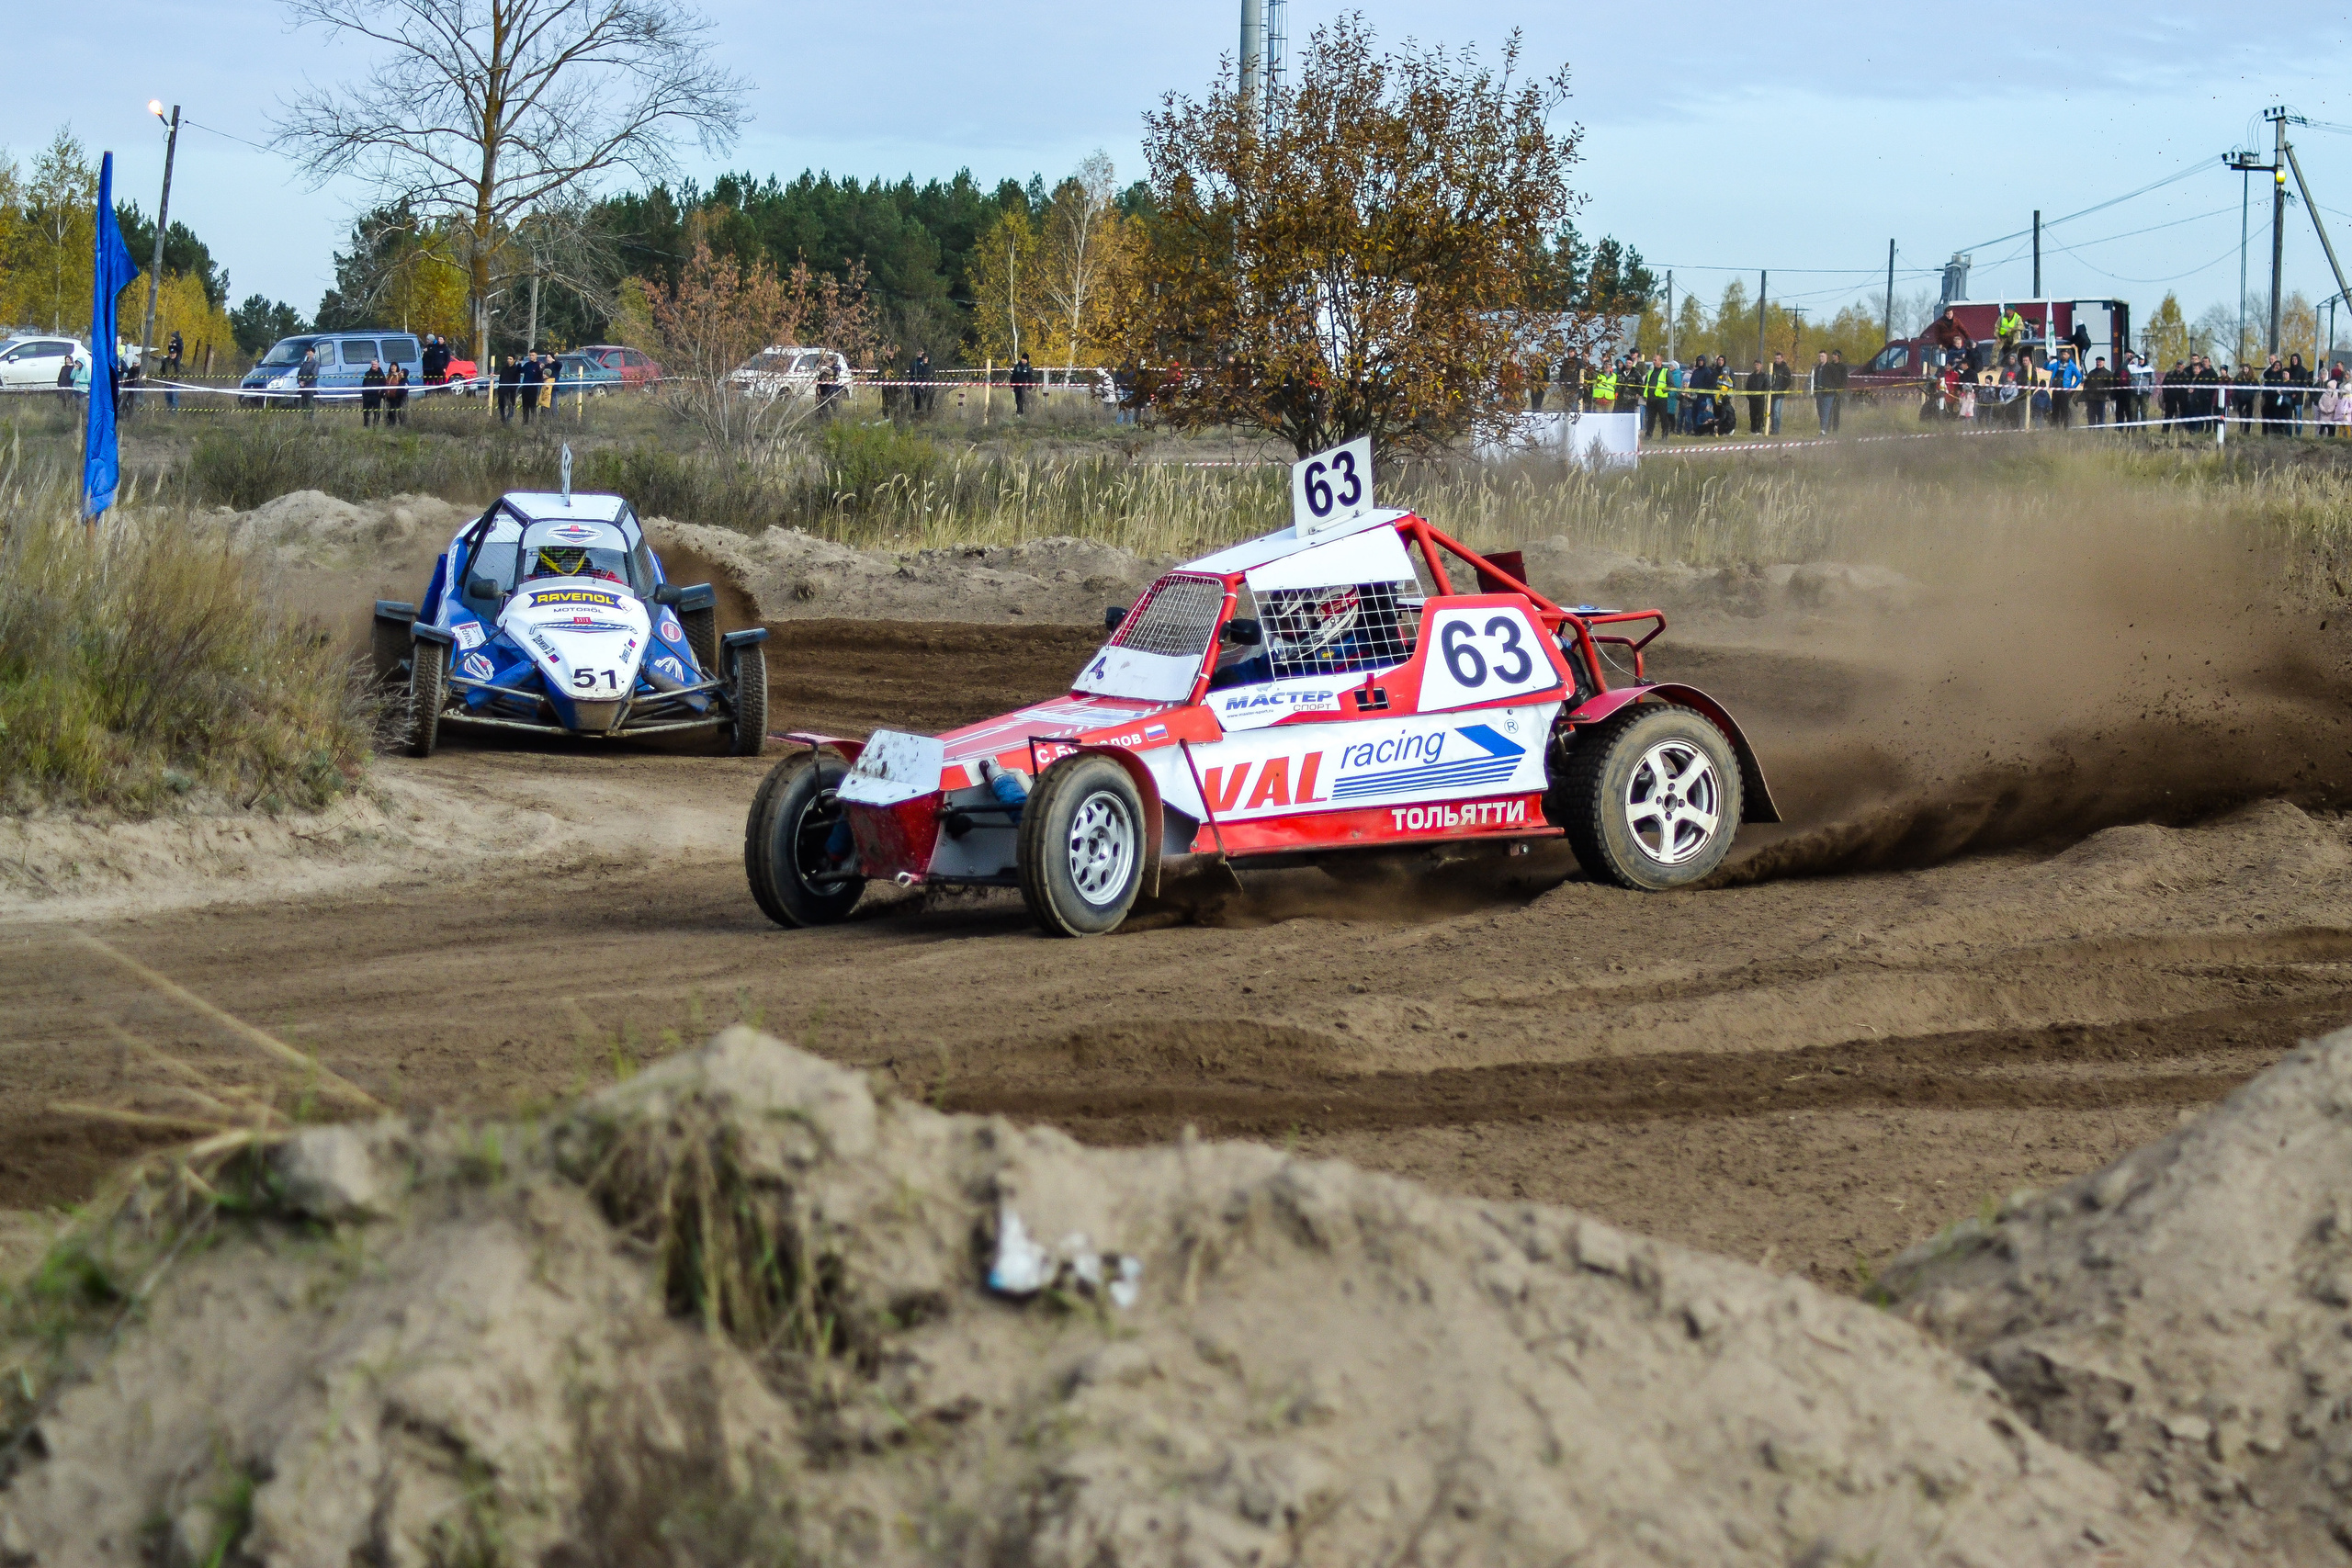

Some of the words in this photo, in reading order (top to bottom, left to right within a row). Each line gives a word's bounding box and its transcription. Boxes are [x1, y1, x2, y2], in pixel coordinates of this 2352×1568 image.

[1304, 450, 1362, 518] 63
[537, 592, 615, 604] RAVENOL
[1442, 615, 1532, 688] 63
[572, 668, 617, 690] 51
[1226, 690, 1333, 711] МАСТЕР
[1204, 750, 1328, 811] VAL
[1340, 730, 1445, 769] racing
[1391, 800, 1525, 830] ТОЛЬЯТТИ
